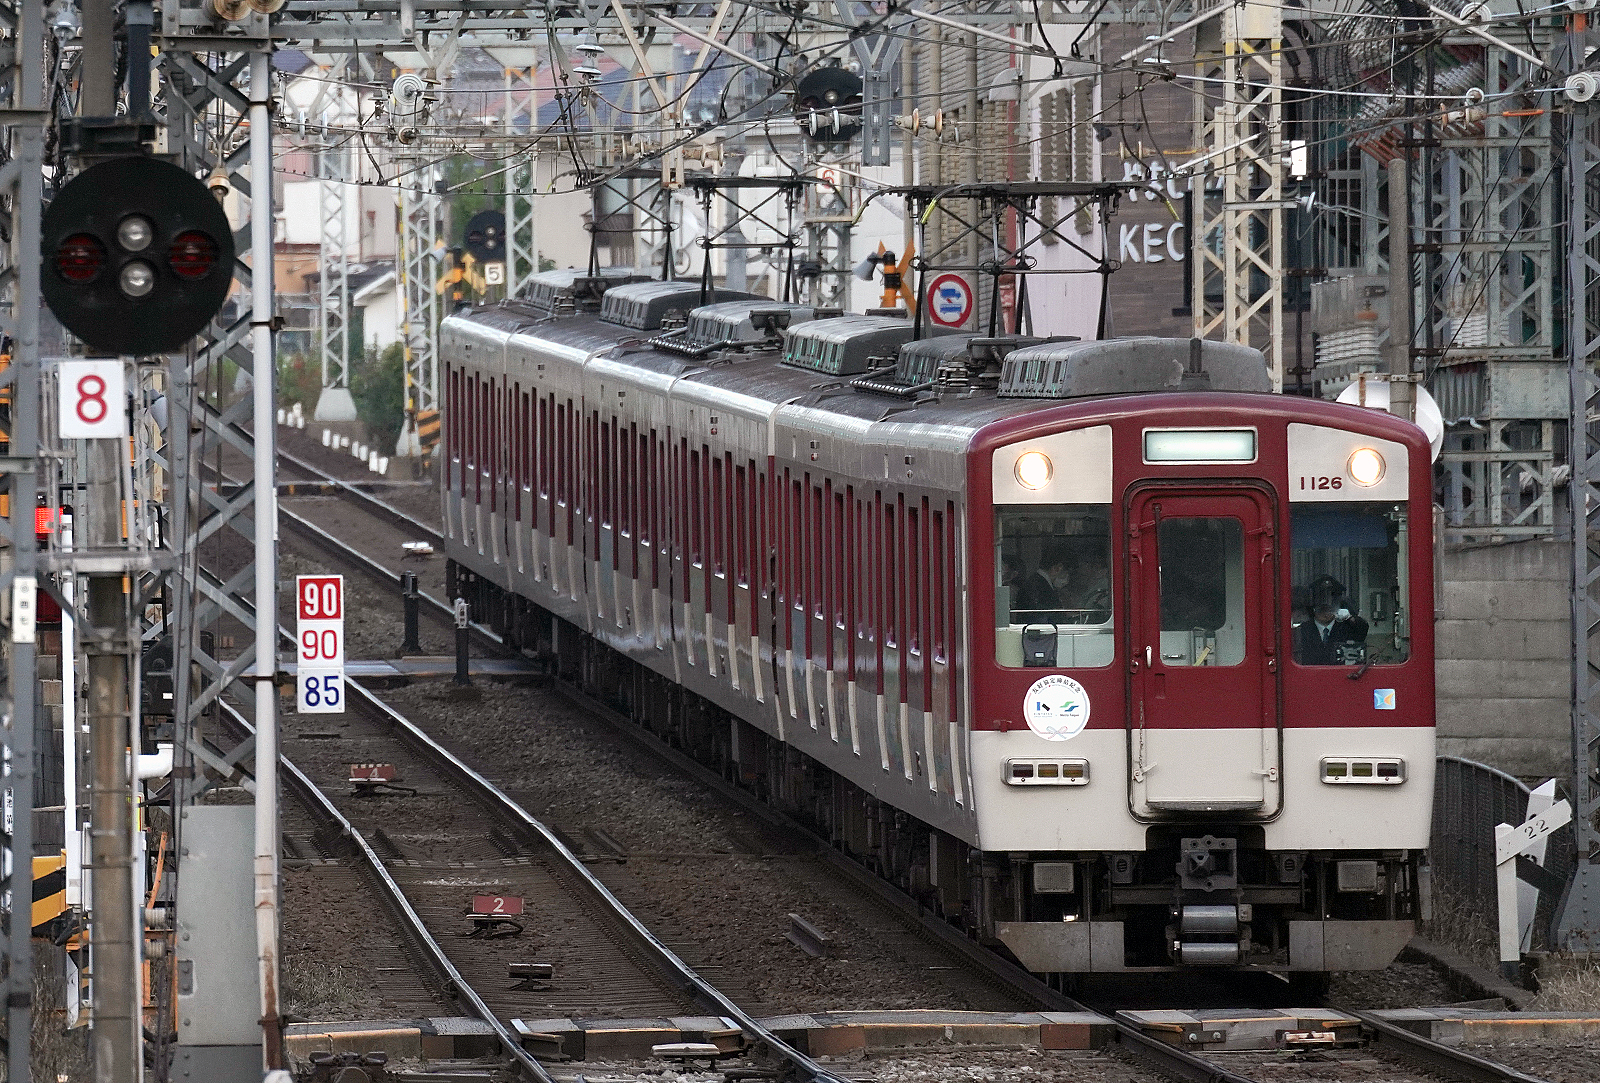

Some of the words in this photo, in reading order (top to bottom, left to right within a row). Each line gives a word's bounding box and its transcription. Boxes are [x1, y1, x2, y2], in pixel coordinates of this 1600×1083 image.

[823, 169, 835, 189] 6
[1119, 222, 1185, 264] KEC
[488, 266, 500, 281] 5
[76, 374, 107, 424] 8
[1300, 476, 1343, 490] 1126
[304, 582, 338, 617] 90
[302, 629, 338, 660] 90
[305, 675, 340, 707] 85
[1524, 819, 1549, 840] 22
[492, 897, 505, 913] 2
